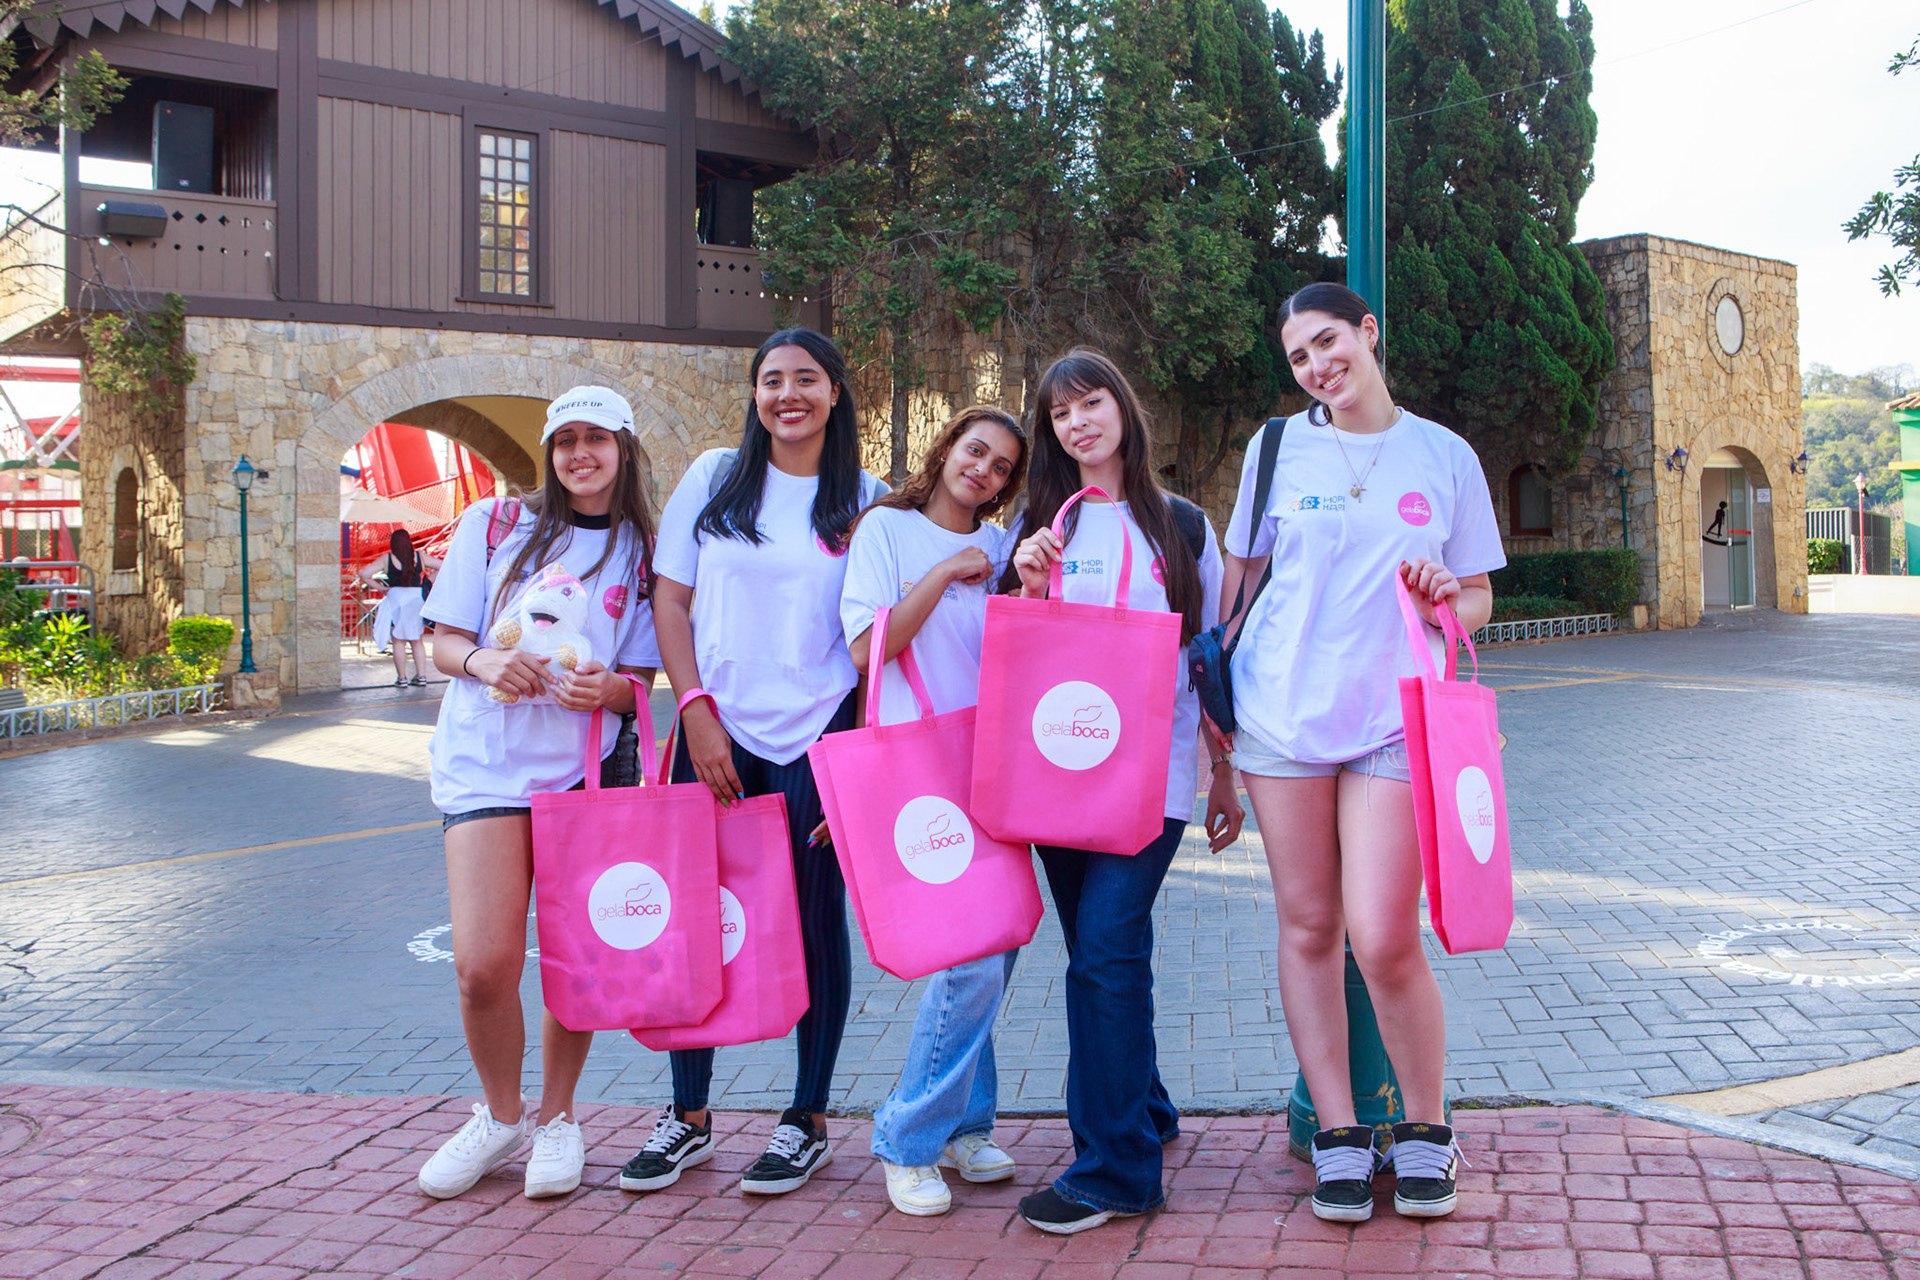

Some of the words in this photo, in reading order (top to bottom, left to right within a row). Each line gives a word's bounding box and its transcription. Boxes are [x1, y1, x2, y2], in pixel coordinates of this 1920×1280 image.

[555, 401, 588, 413] WHEELS
[1042, 720, 1110, 740] gelaboca
[905, 833, 966, 859] gelaboca
[597, 901, 662, 921] gelaboca
